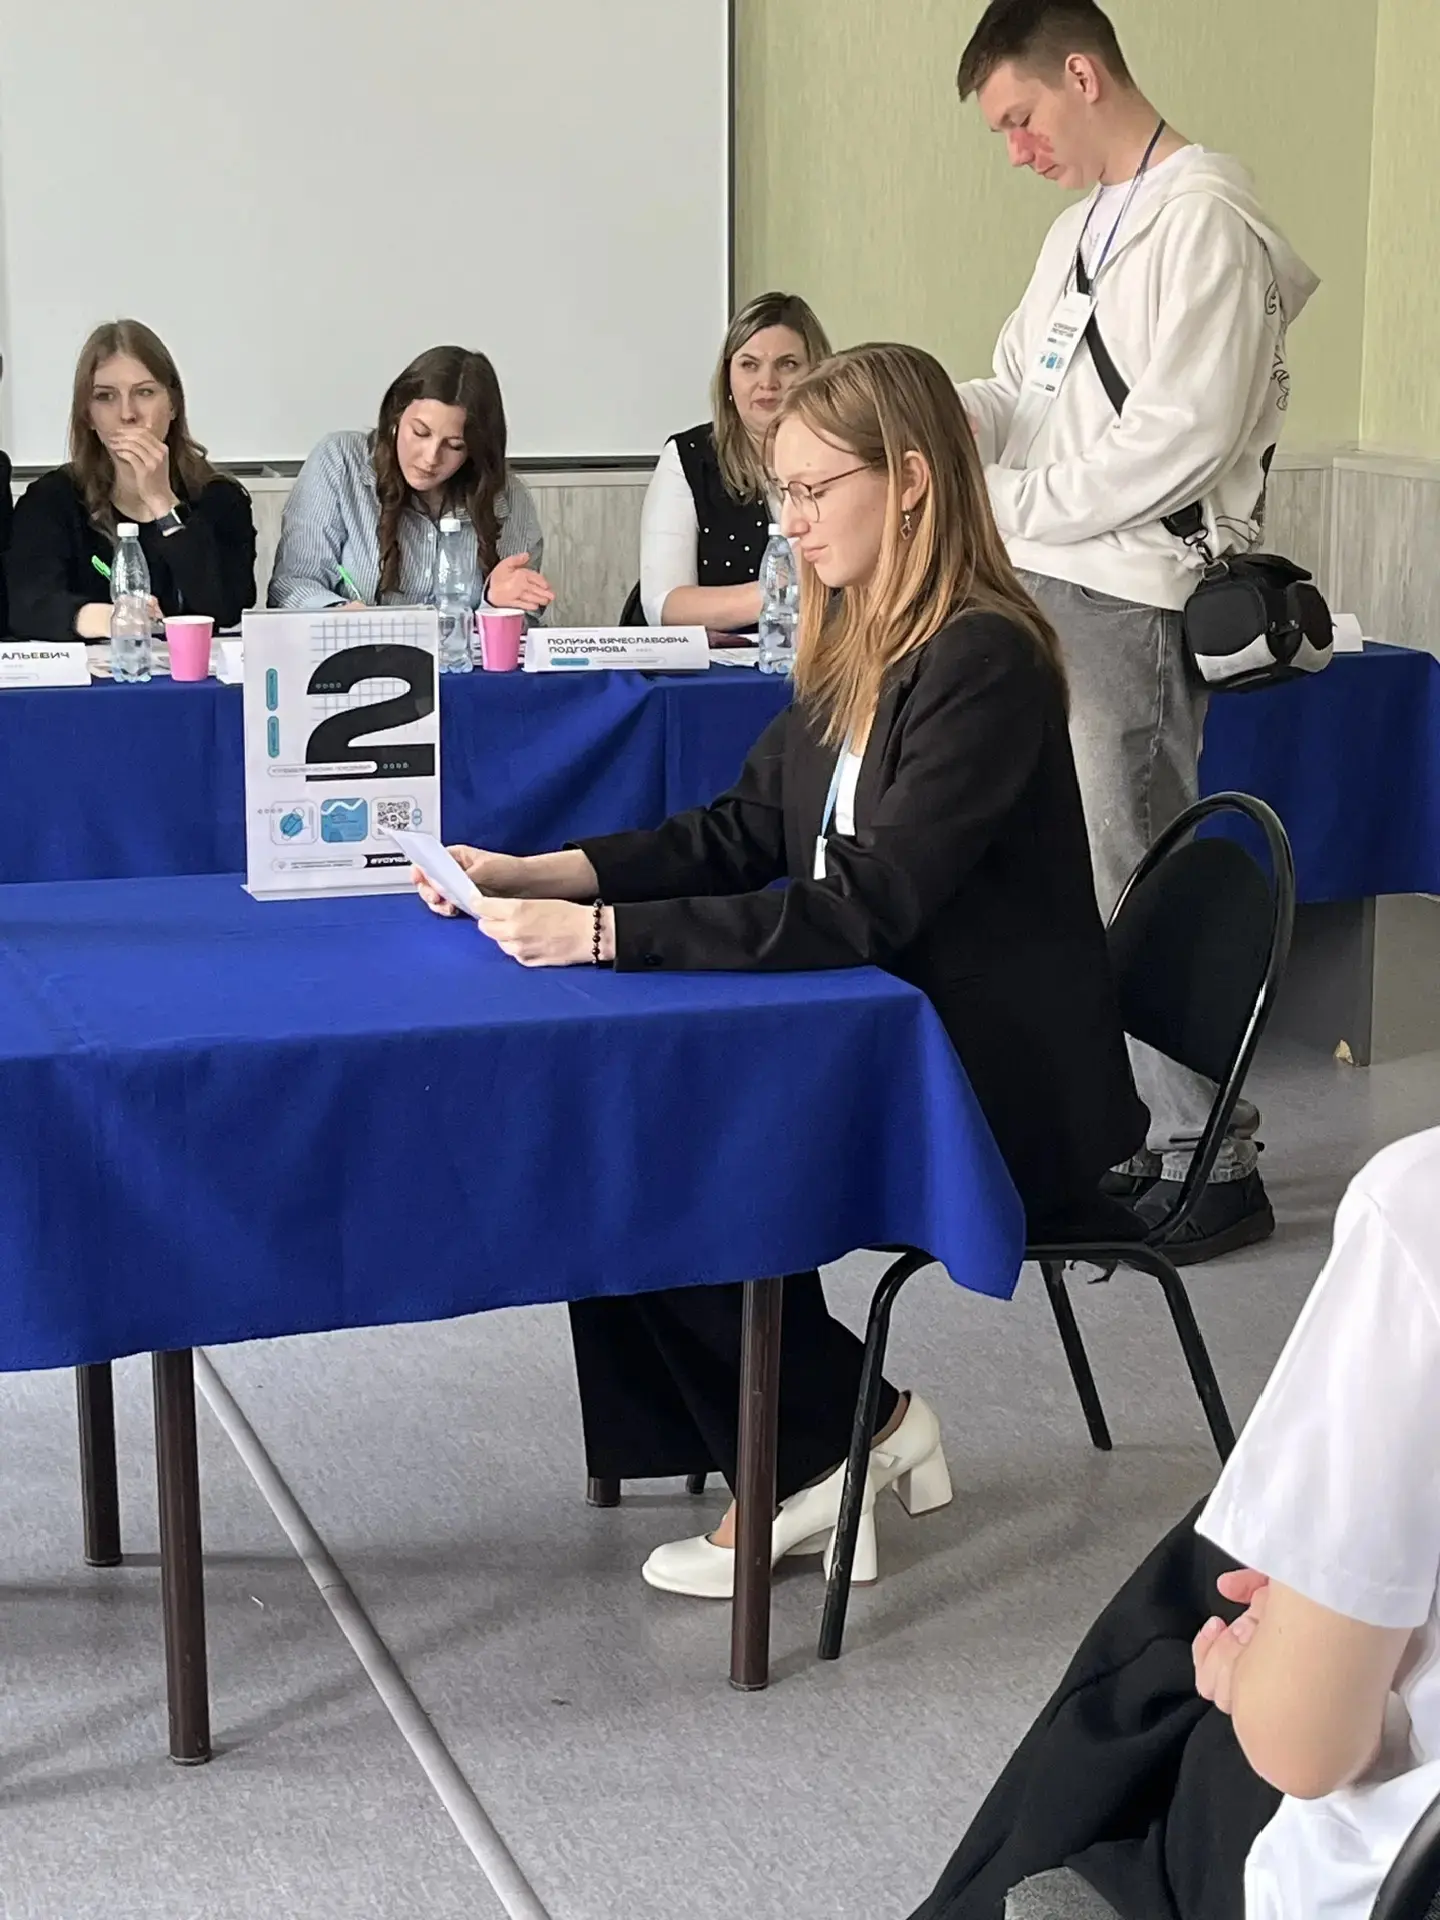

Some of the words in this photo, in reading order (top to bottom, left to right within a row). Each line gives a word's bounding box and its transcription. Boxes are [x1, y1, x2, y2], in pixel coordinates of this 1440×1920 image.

[547, 638, 597, 646] ПОЛИНА
[598, 636, 690, 645] ВЯЧЕСЛАВОВНА
[549, 645, 627, 654] ПОДГОРНОВА
[305, 643, 435, 782] 2
